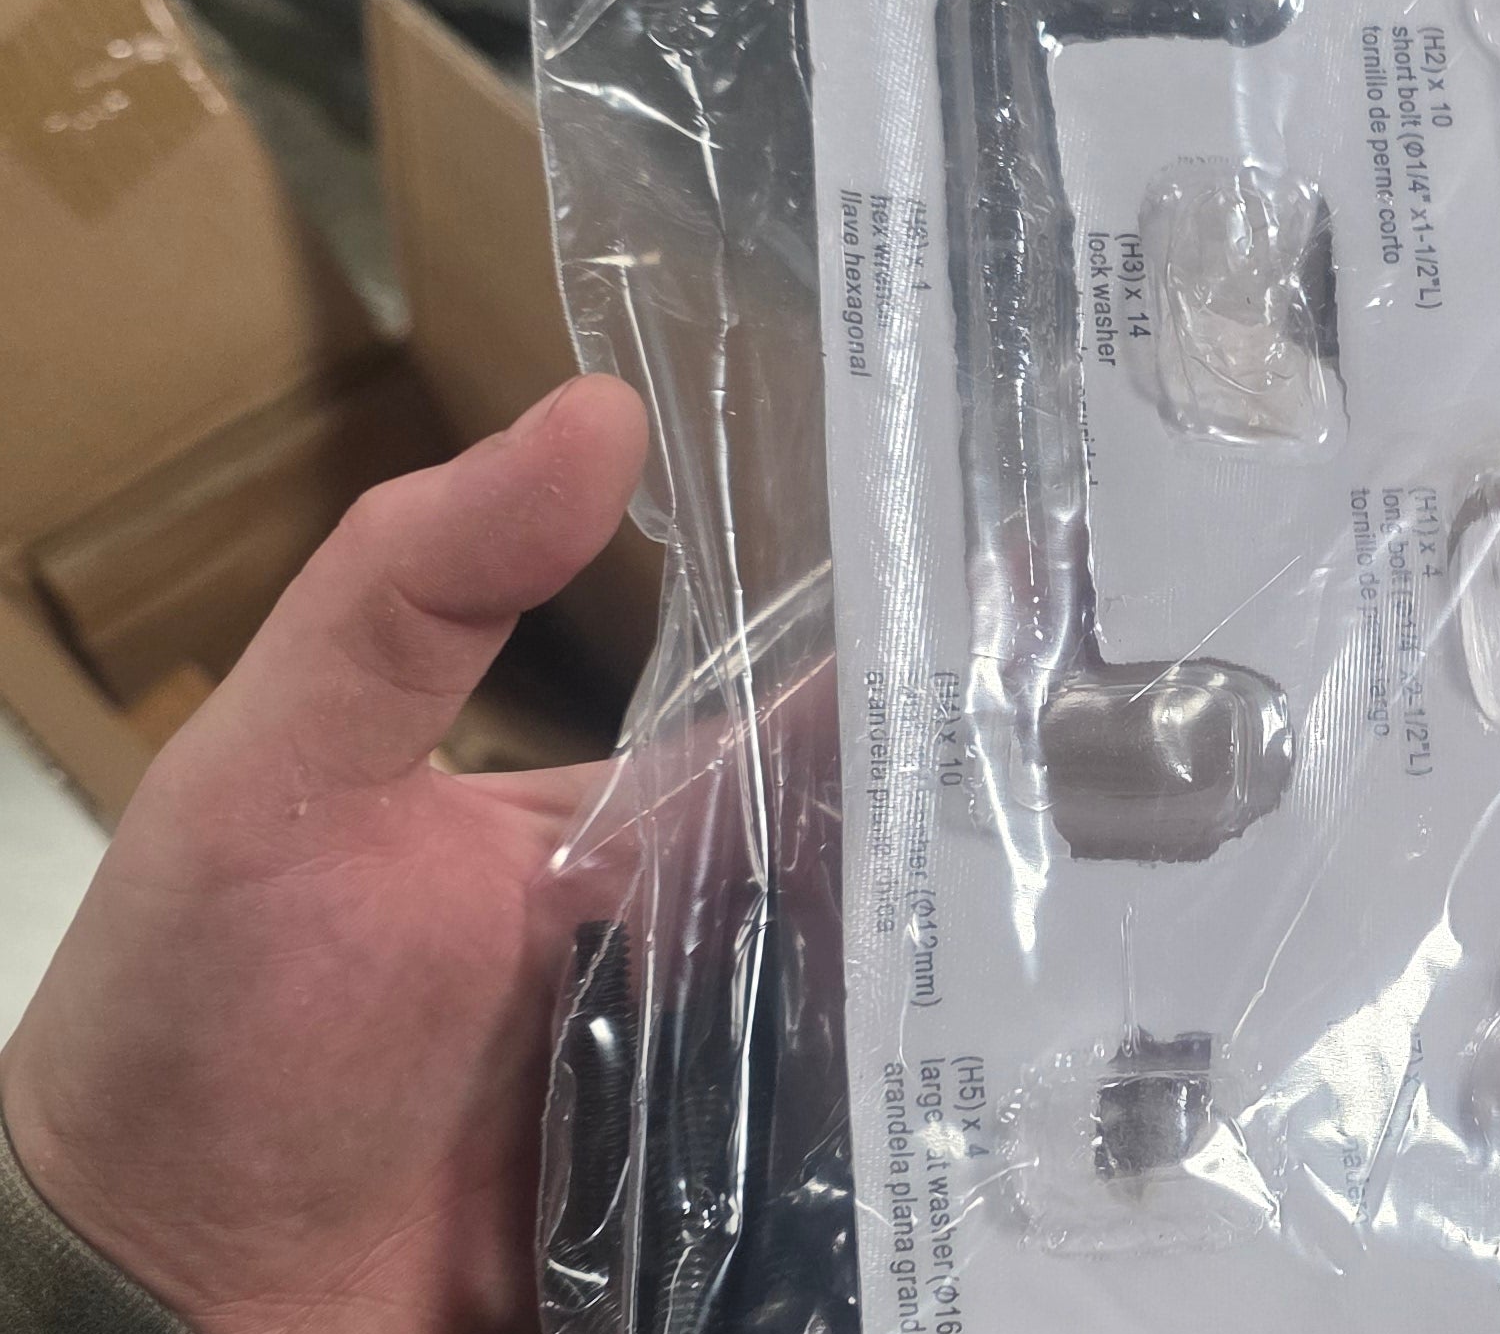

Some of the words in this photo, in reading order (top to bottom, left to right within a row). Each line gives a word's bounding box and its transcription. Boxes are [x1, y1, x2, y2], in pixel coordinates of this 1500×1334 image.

[1362, 25, 1388, 100] tornillo
[1392, 26, 1417, 81] short
[1417, 27, 1447, 73] (H2)
[1398, 87, 1422, 127] bolt
[1428, 78, 1444, 91] x
[1368, 107, 1391, 133] de
[1430, 102, 1453, 127] 10
[841, 189, 863, 246] llave
[870, 195, 894, 238] hex
[1379, 208, 1403, 264] corto
[1088, 232, 1113, 279] lock
[1114, 233, 1146, 282] (H3)
[842, 251, 873, 377] hexagonal
[1124, 286, 1142, 300] x
[1093, 283, 1119, 366] washer
[1127, 312, 1152, 338] 14
[1350, 486, 1378, 566] tornillo
[1380, 487, 1404, 534] long
[1407, 487, 1440, 536] (H1)
[1387, 540, 1412, 585] bolt
[1419, 541, 1436, 554] x
[1421, 563, 1443, 578] 4
[1359, 572, 1381, 600] de
[939, 731, 957, 745] x
[939, 758, 963, 786] 10
[916, 1058, 946, 1124] large
[950, 1056, 987, 1111] (H5)
[884, 1062, 914, 1175] arandela
[961, 1118, 981, 1132] x
[964, 1144, 990, 1159] 4
[884, 1182, 919, 1252] plana
[928, 1175, 957, 1269] washer
